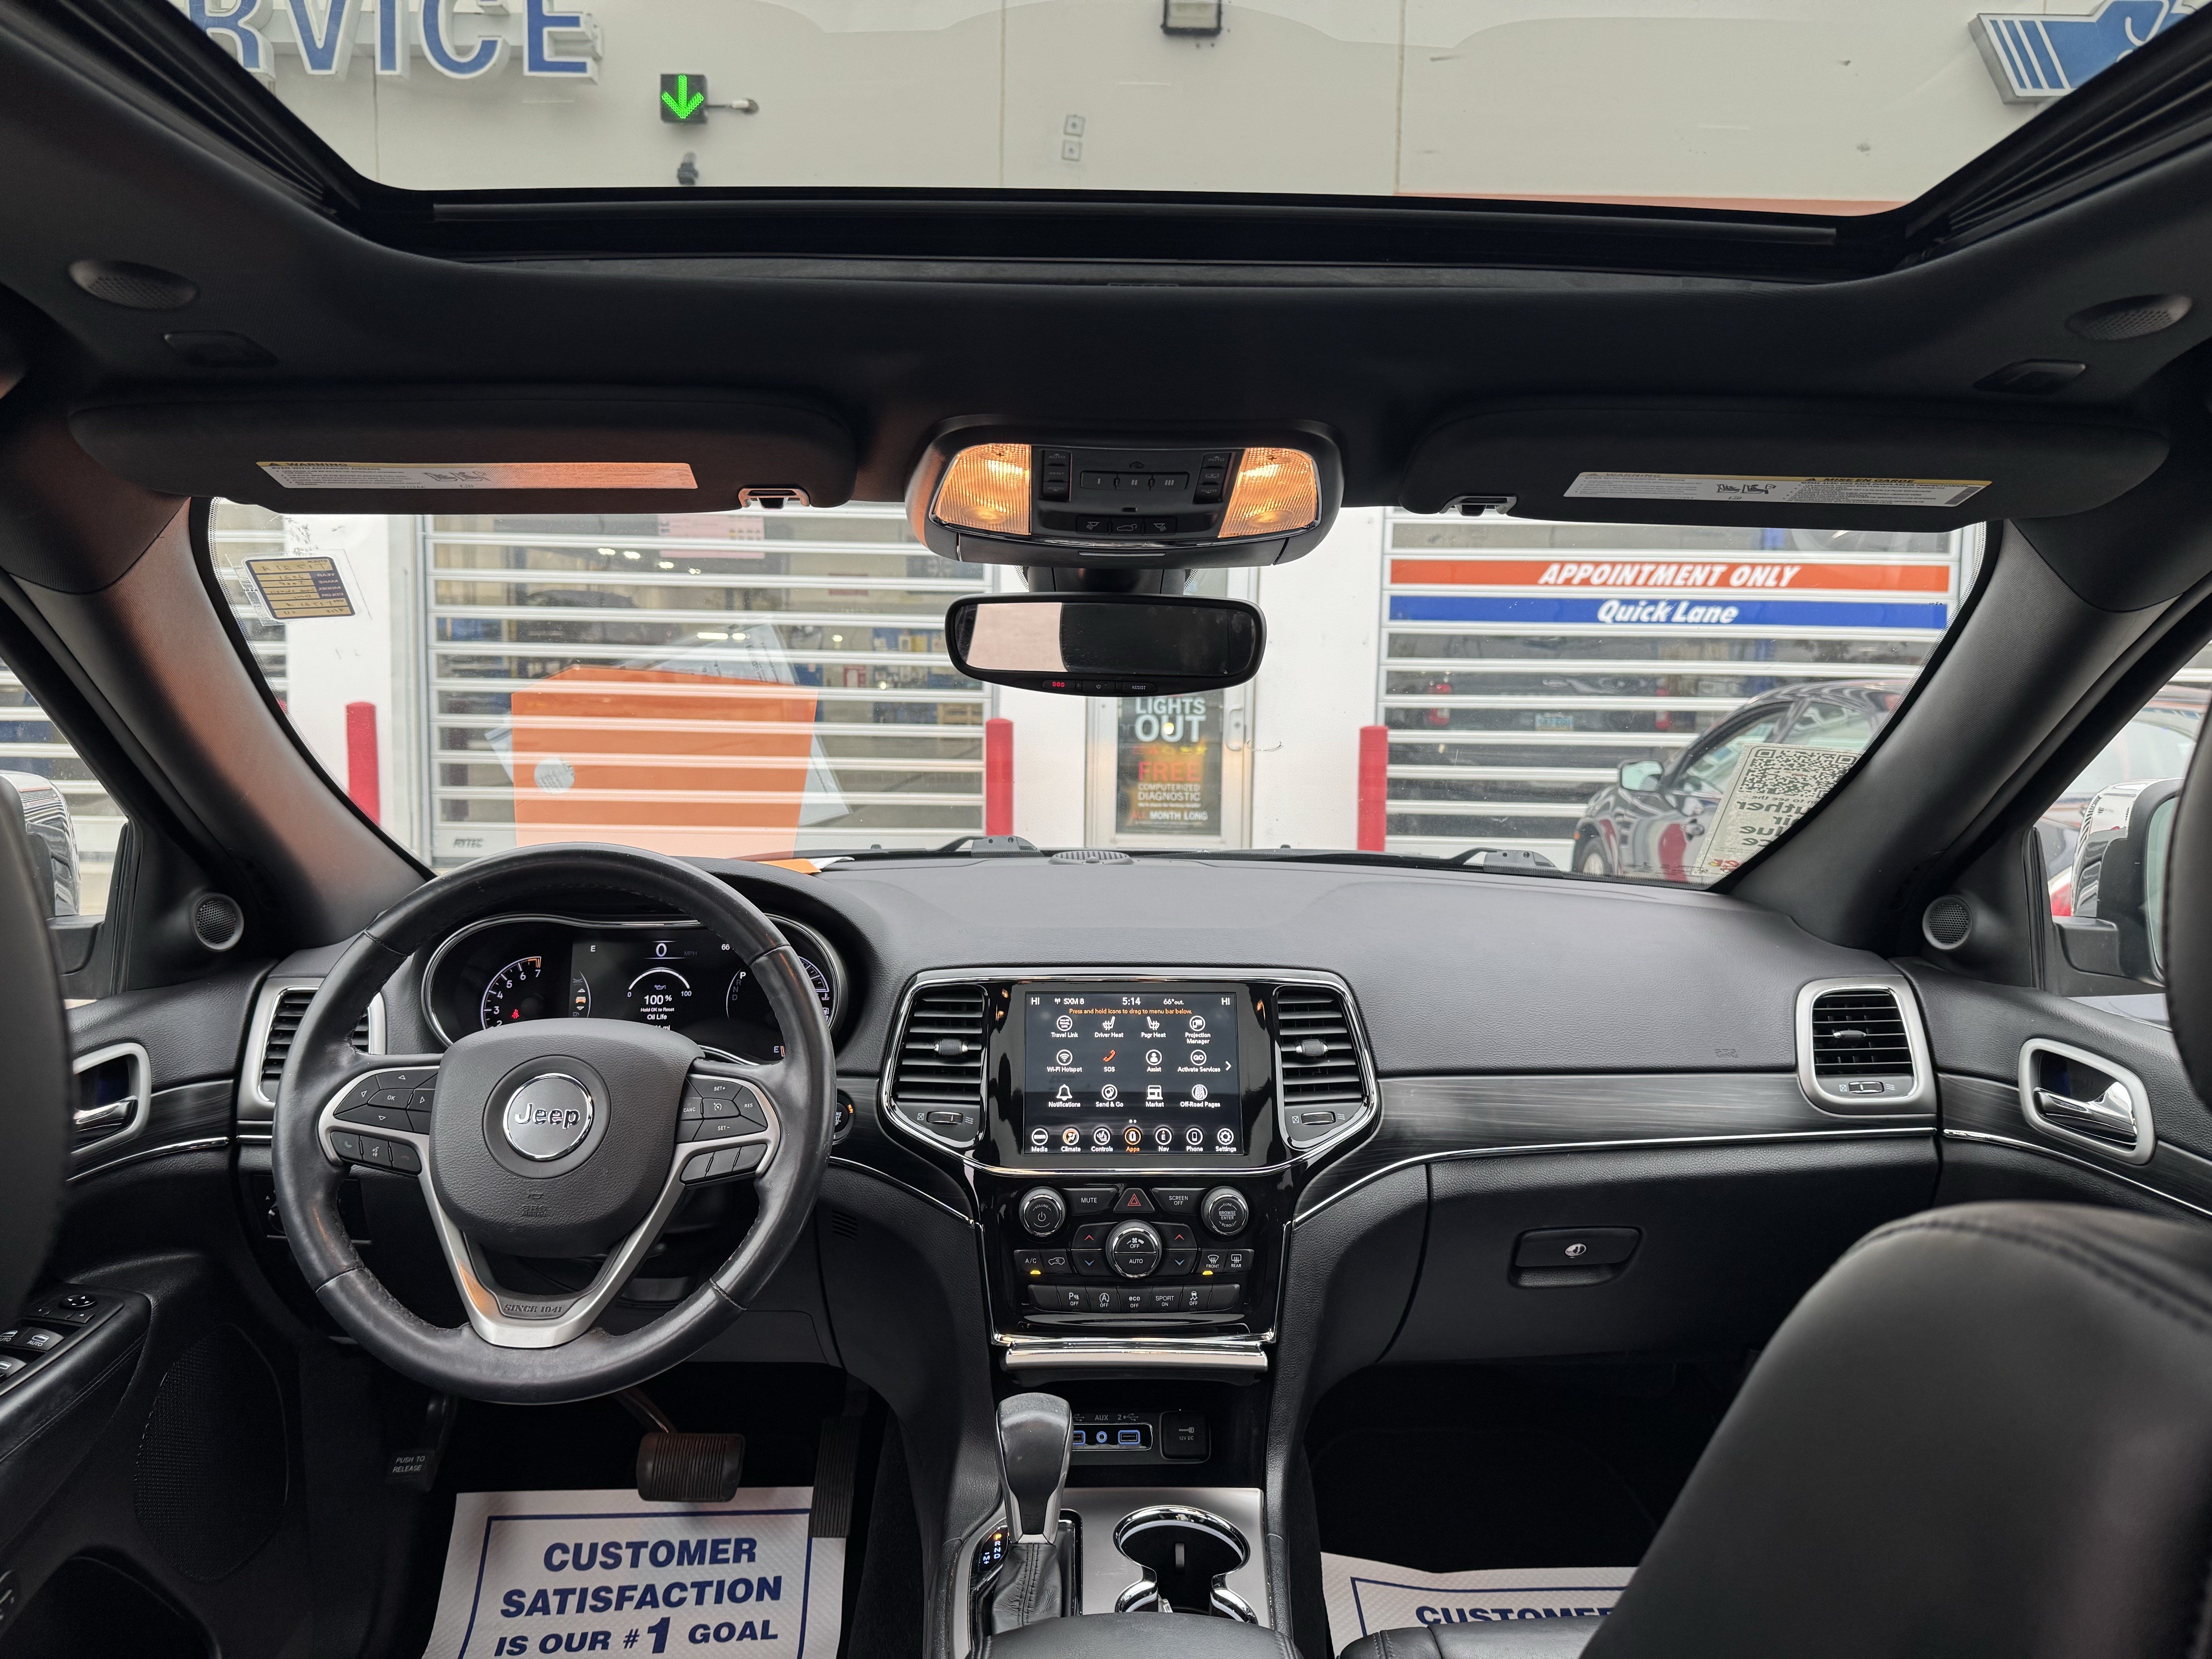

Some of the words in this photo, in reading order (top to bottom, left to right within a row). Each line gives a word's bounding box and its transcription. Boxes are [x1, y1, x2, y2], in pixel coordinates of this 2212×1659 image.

[1539, 563, 1728, 586] APPOINTMENT
[1729, 565, 1802, 587] ONLY
[1598, 598, 1669, 624] Quick
[1670, 601, 1739, 624] Lane
[1135, 698, 1206, 714] LIGHTS
[1135, 714, 1207, 742] OUT
[1138, 761, 1200, 782] FREE
[1138, 792, 1201, 801] DIAGNOSTIC
[1149, 811, 1182, 820] MONTH
[1184, 811, 1208, 821] LONG
[520, 972, 526, 980] 6
[535, 969, 541, 977] 7
[497, 991, 503, 999] 4
[1122, 997, 1141, 1005] 5:14
[1221, 997, 1230, 1005] HI
[493, 1006, 500, 1014] 3
[515, 1103, 580, 1129] Jeep
[393, 1465, 422, 1473] RELEASE
[543, 1537, 757, 1572] CUSTOMER
[500, 1576, 782, 1618] SATISFACTION
[494, 1635, 528, 1656] IS
[538, 1630, 612, 1654] OUR
[688, 1620, 778, 1644] GOAL
